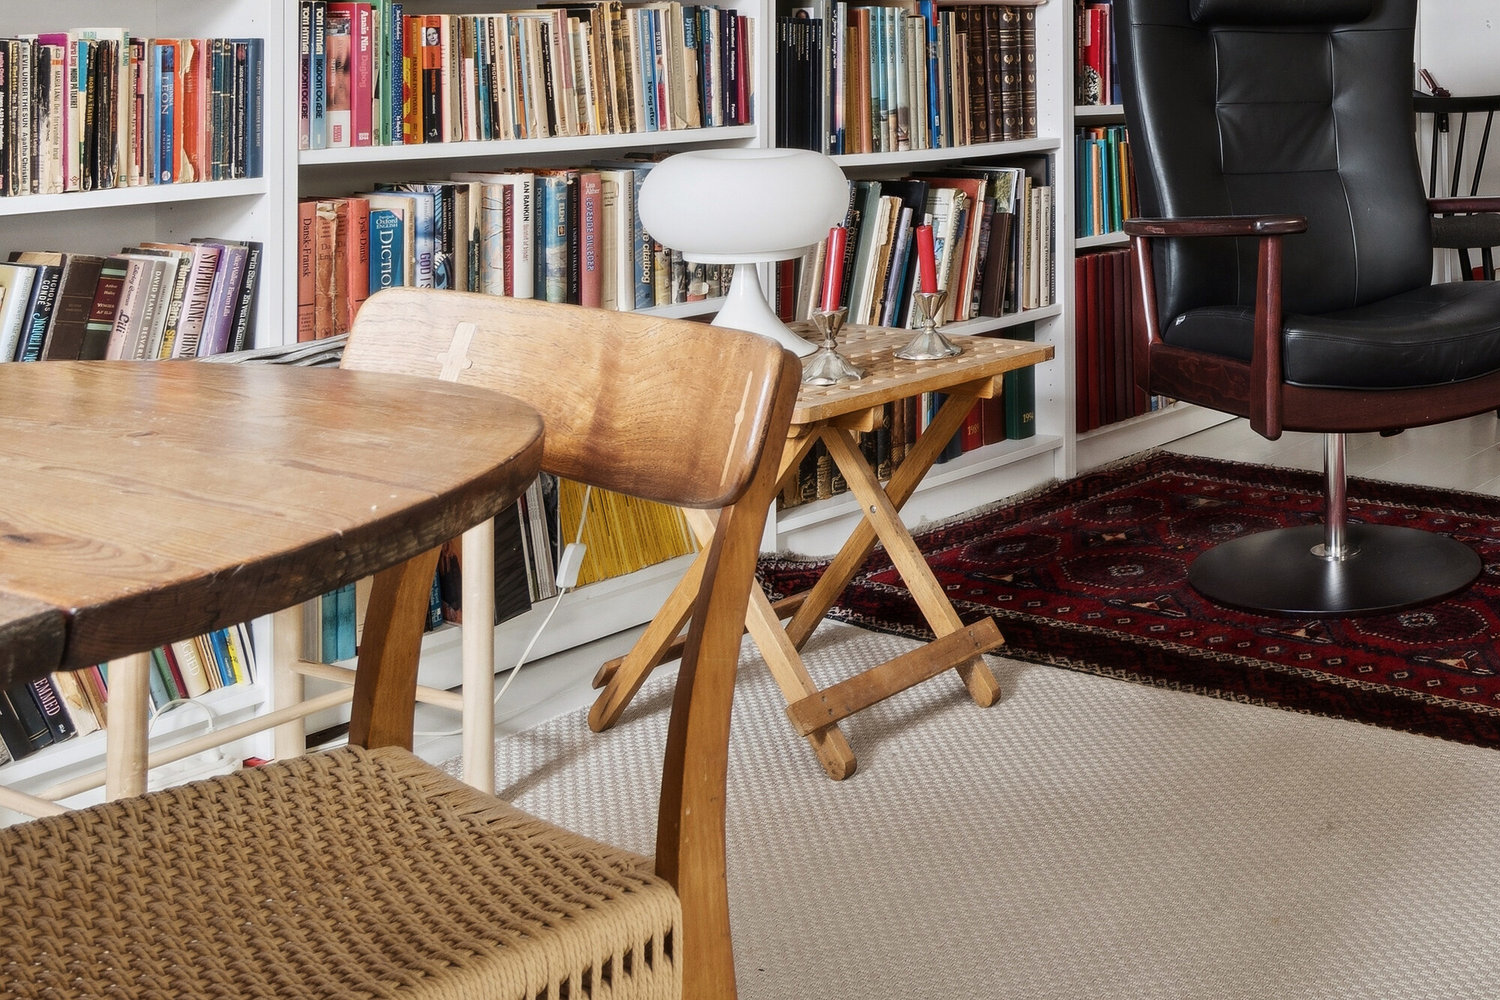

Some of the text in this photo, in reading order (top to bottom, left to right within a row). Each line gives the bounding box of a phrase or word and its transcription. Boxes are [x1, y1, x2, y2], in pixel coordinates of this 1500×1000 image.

[360, 10, 369, 34] Anaïs
[360, 36, 369, 51] Nin
[301, 7, 311, 119] TOM HYMAN RIGDOM OG ÆRE
[315, 7, 324, 119] TOM HYMAN RIGDOM OG ÆRE
[69, 90, 78, 108] TEATRET
[248, 250, 259, 269] Irwin
[303, 218, 311, 277] Dansk-Fransk
[420, 253, 430, 274] GOD
[642, 244, 650, 283] citatbog
[187, 254, 217, 322] STEPHEN KING
[246, 270, 256, 289] Shaw
[38, 280, 51, 305] CONDÉ
[44, 274, 59, 312] NICHOLAS
[145, 271, 162, 320] DAVID PLANTE
[168, 265, 192, 326] Norman Garbo
[243, 295, 251, 304] En
[116, 310, 130, 333] Lili
[240, 305, 249, 316] ven
